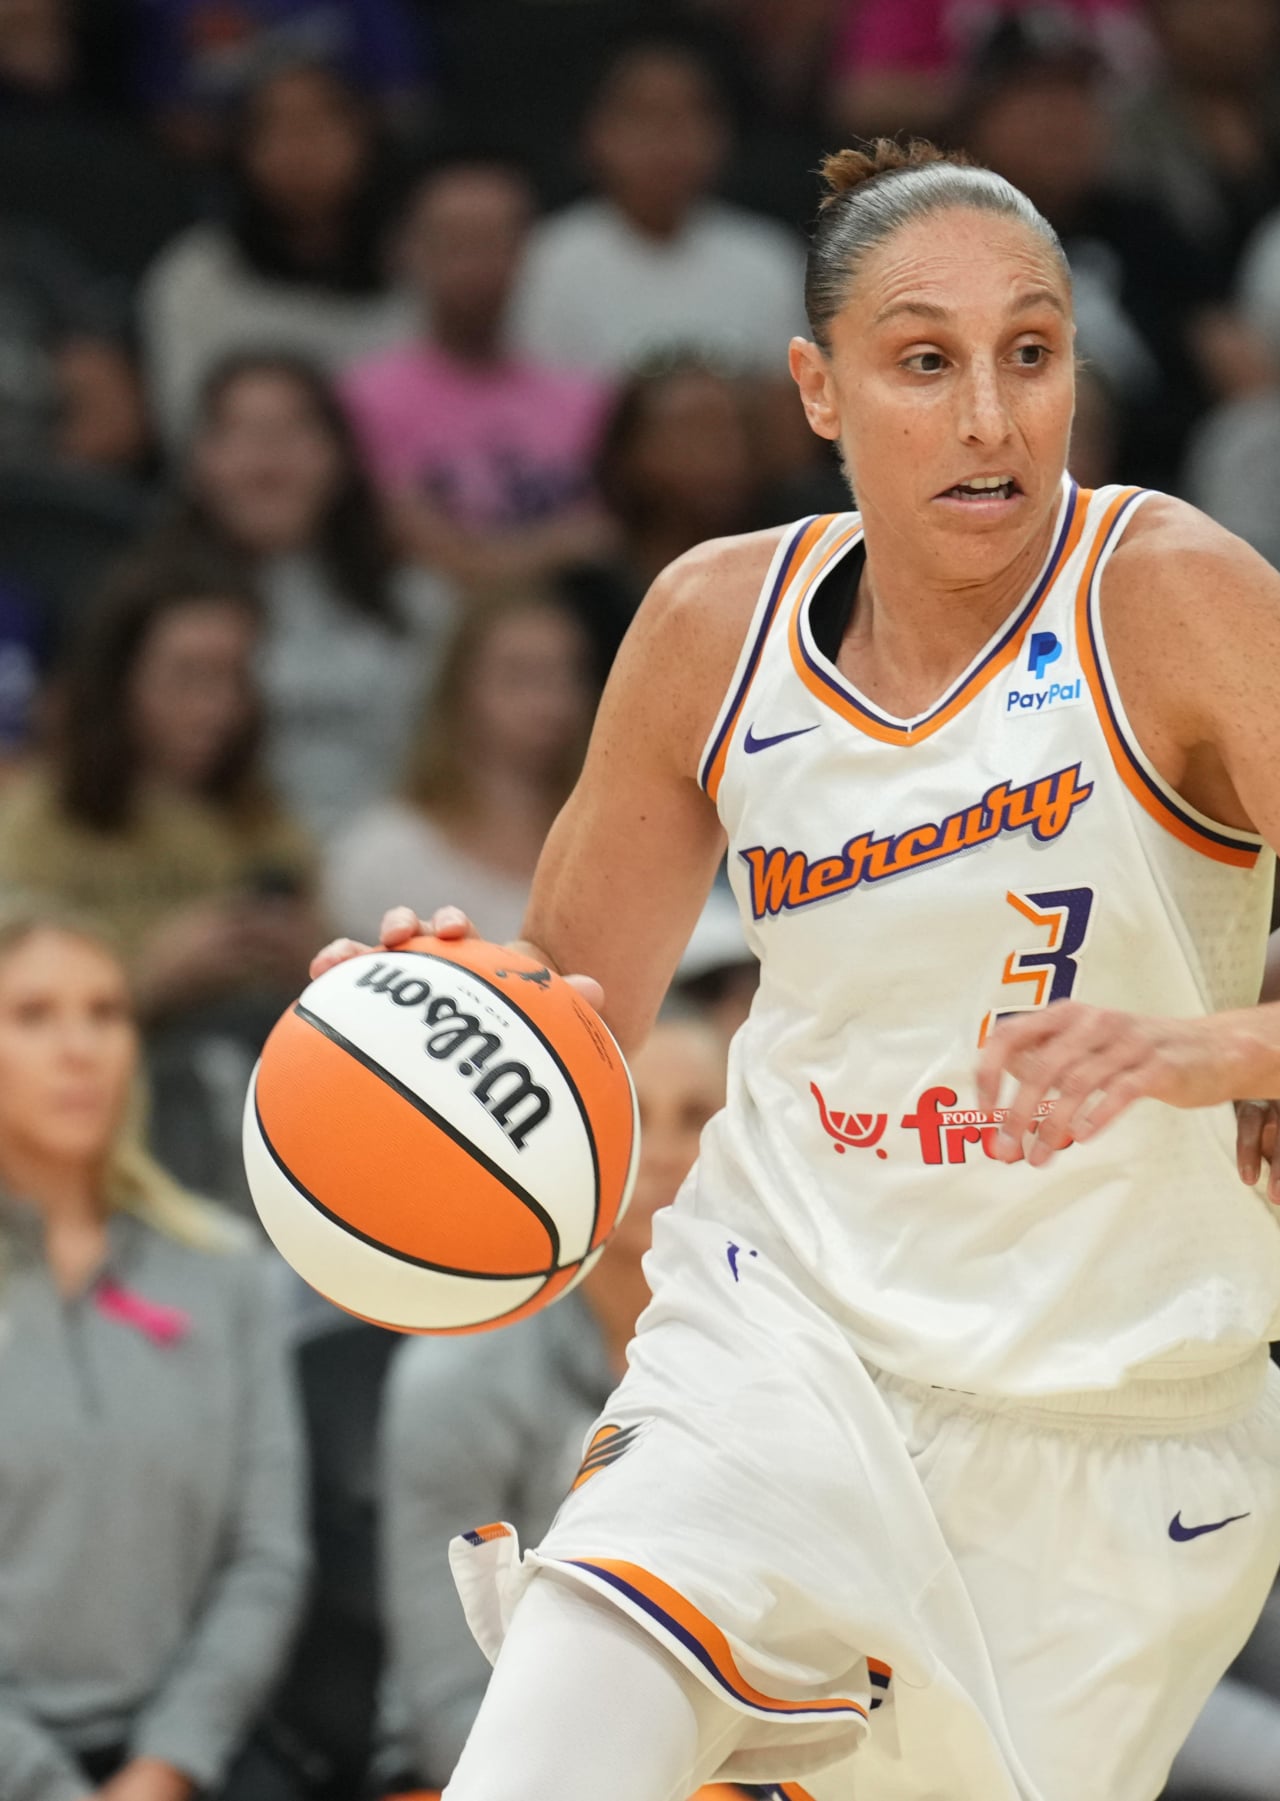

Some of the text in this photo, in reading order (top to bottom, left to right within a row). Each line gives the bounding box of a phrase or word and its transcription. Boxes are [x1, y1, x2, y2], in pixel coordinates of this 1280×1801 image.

[1007, 679, 1081, 712] PayPal
[739, 762, 1094, 920] Mercury
[977, 887, 1094, 1050] 3
[356, 961, 552, 1153] Wilson
[942, 1110, 988, 1125] FOOD
